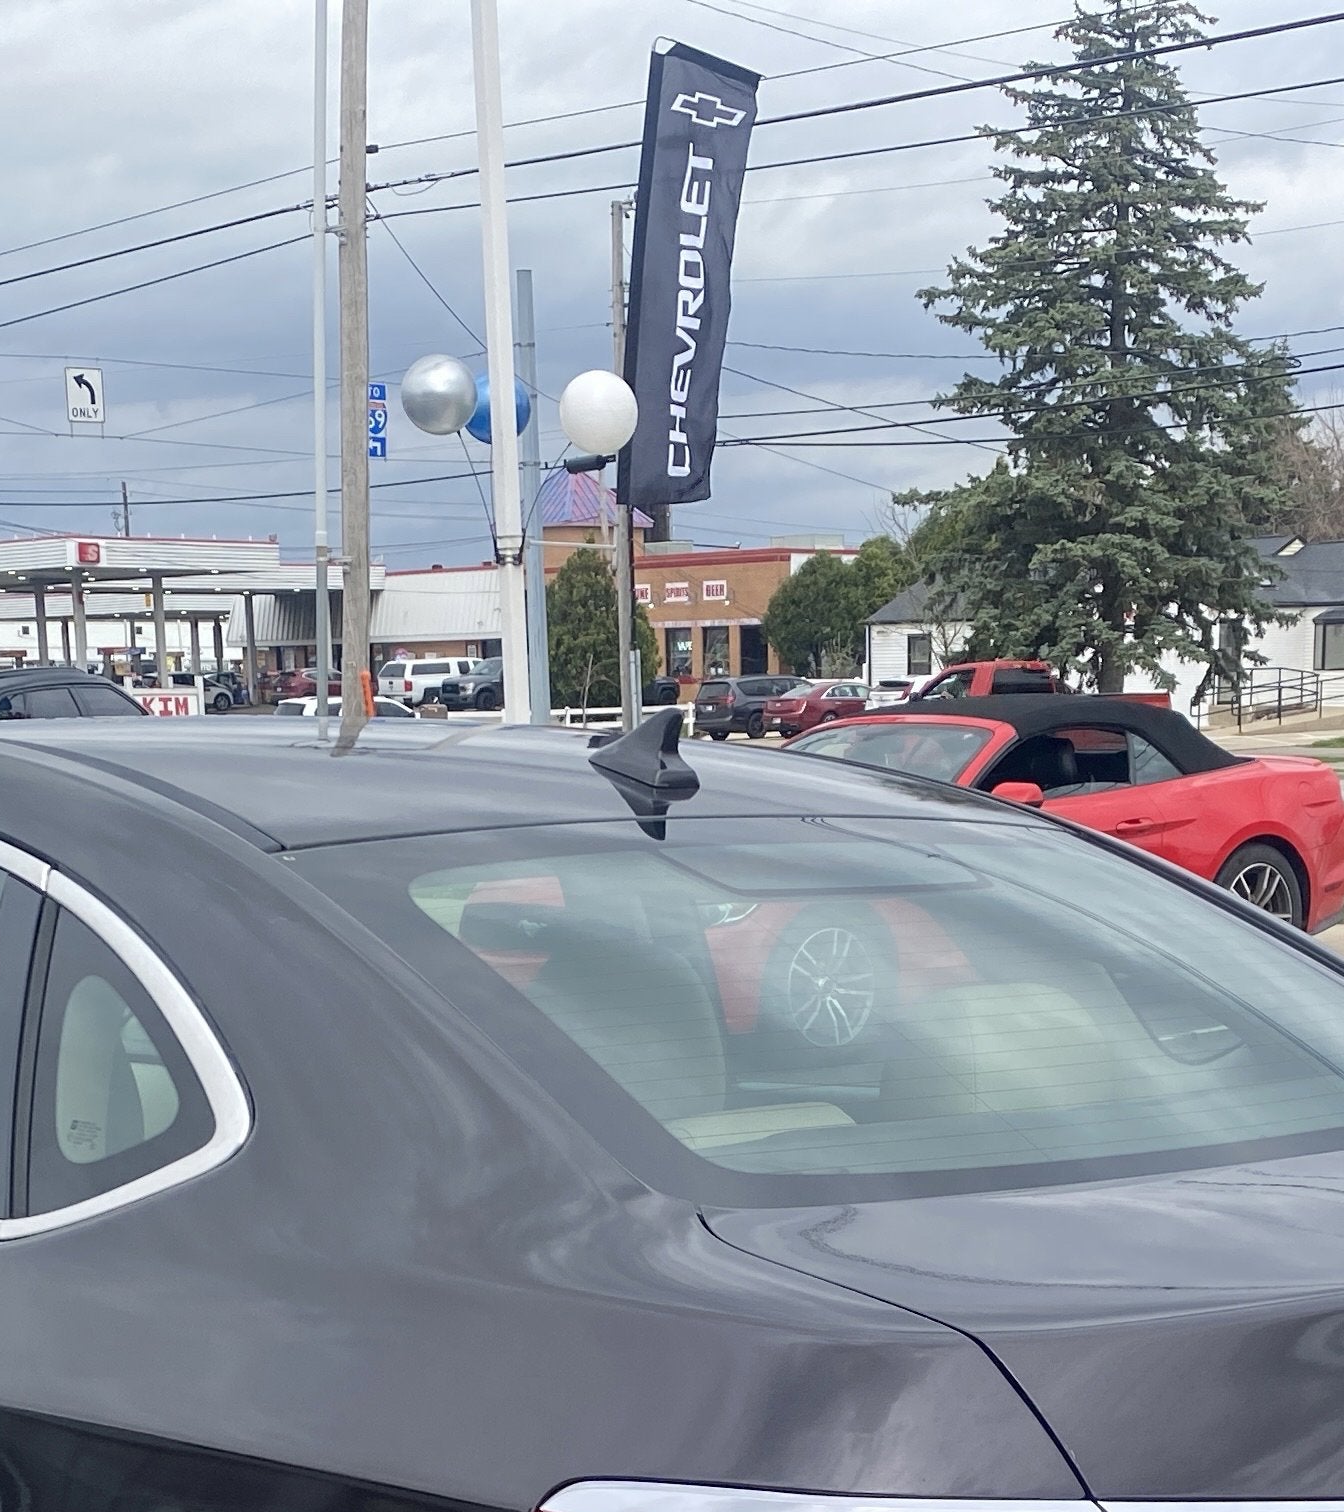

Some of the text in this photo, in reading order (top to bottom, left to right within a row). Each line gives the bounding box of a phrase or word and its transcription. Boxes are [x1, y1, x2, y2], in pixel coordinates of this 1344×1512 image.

[667, 142, 714, 478] CHEVROLET
[71, 407, 99, 419] ONLY
[635, 587, 649, 600] INE
[705, 584, 725, 597] BEER
[142, 696, 189, 716] KIM
